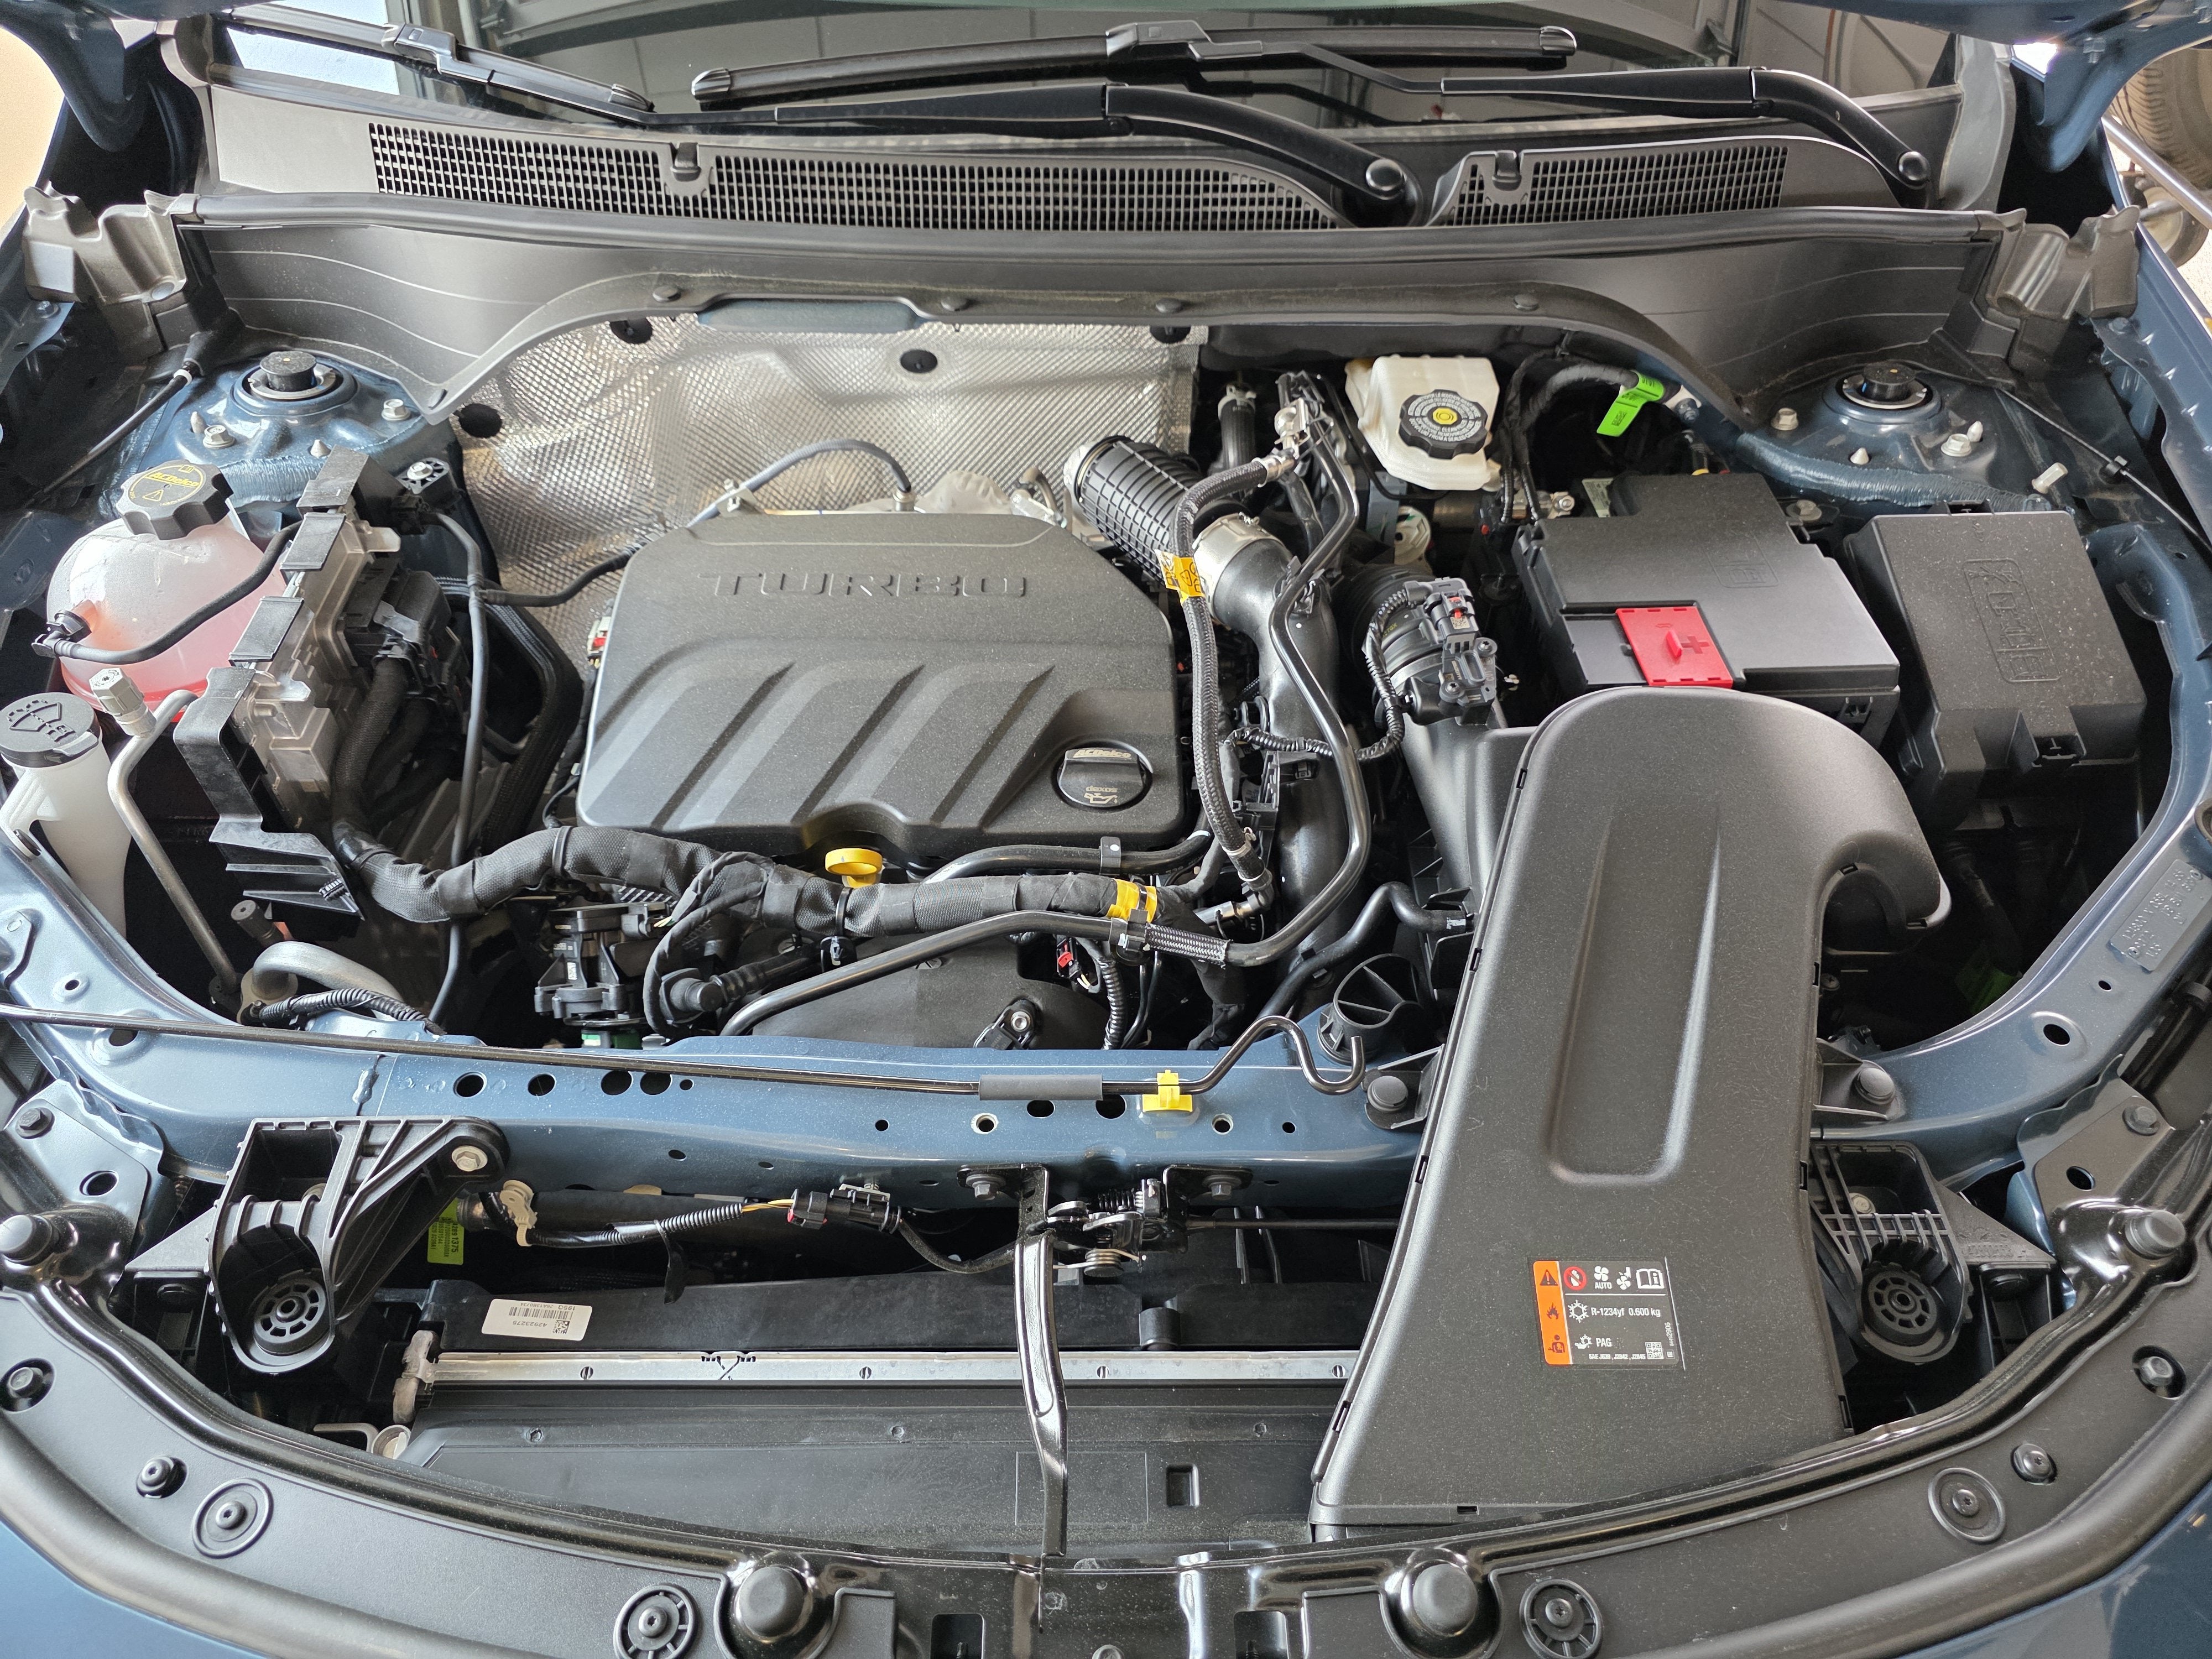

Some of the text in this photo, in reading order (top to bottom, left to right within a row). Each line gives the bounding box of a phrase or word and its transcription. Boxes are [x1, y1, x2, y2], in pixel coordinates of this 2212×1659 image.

[146, 472, 200, 487] ACDelco
[697, 572, 1026, 597] TURBO
[1074, 749, 1132, 758] ACDelco
[1590, 1307, 1661, 1318] R-1234yf 0.600 kg
[1595, 1338, 1613, 1347] PAG
